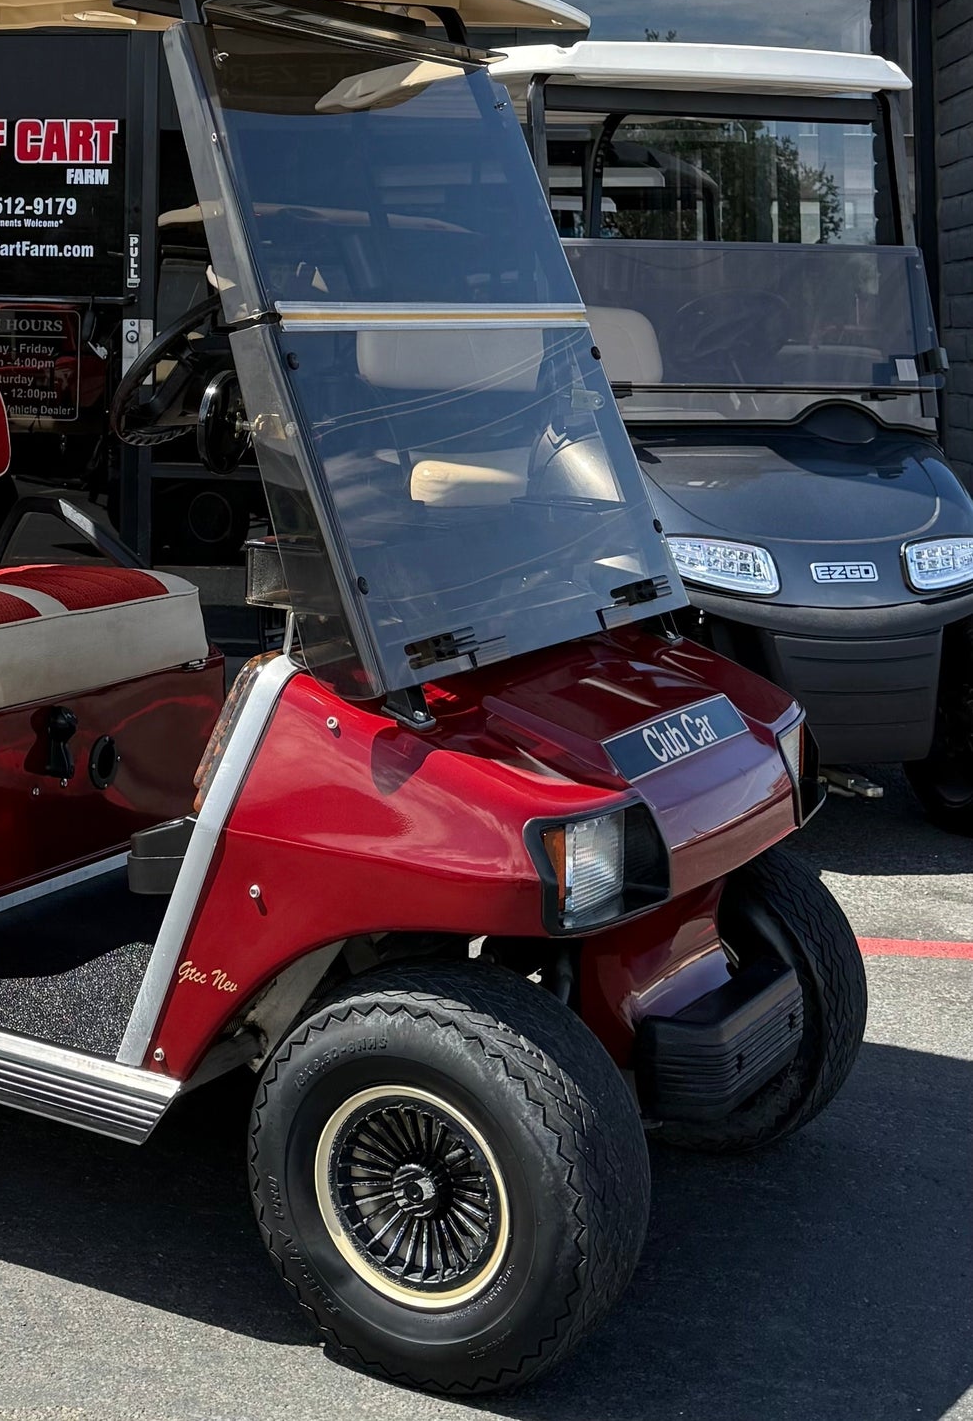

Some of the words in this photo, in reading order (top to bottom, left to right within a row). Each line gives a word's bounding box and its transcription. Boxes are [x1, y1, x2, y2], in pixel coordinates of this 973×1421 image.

[15, 119, 119, 164] CART
[66, 168, 109, 185] FARM
[129, 236, 139, 278] PULL
[5, 319, 64, 332] HOURS
[19, 343, 55, 356] Friday
[14, 358, 55, 369] 4:00pm
[11, 388, 58, 399] 12:00pm
[642, 722, 690, 763] Club
[680, 713, 718, 746] Car
